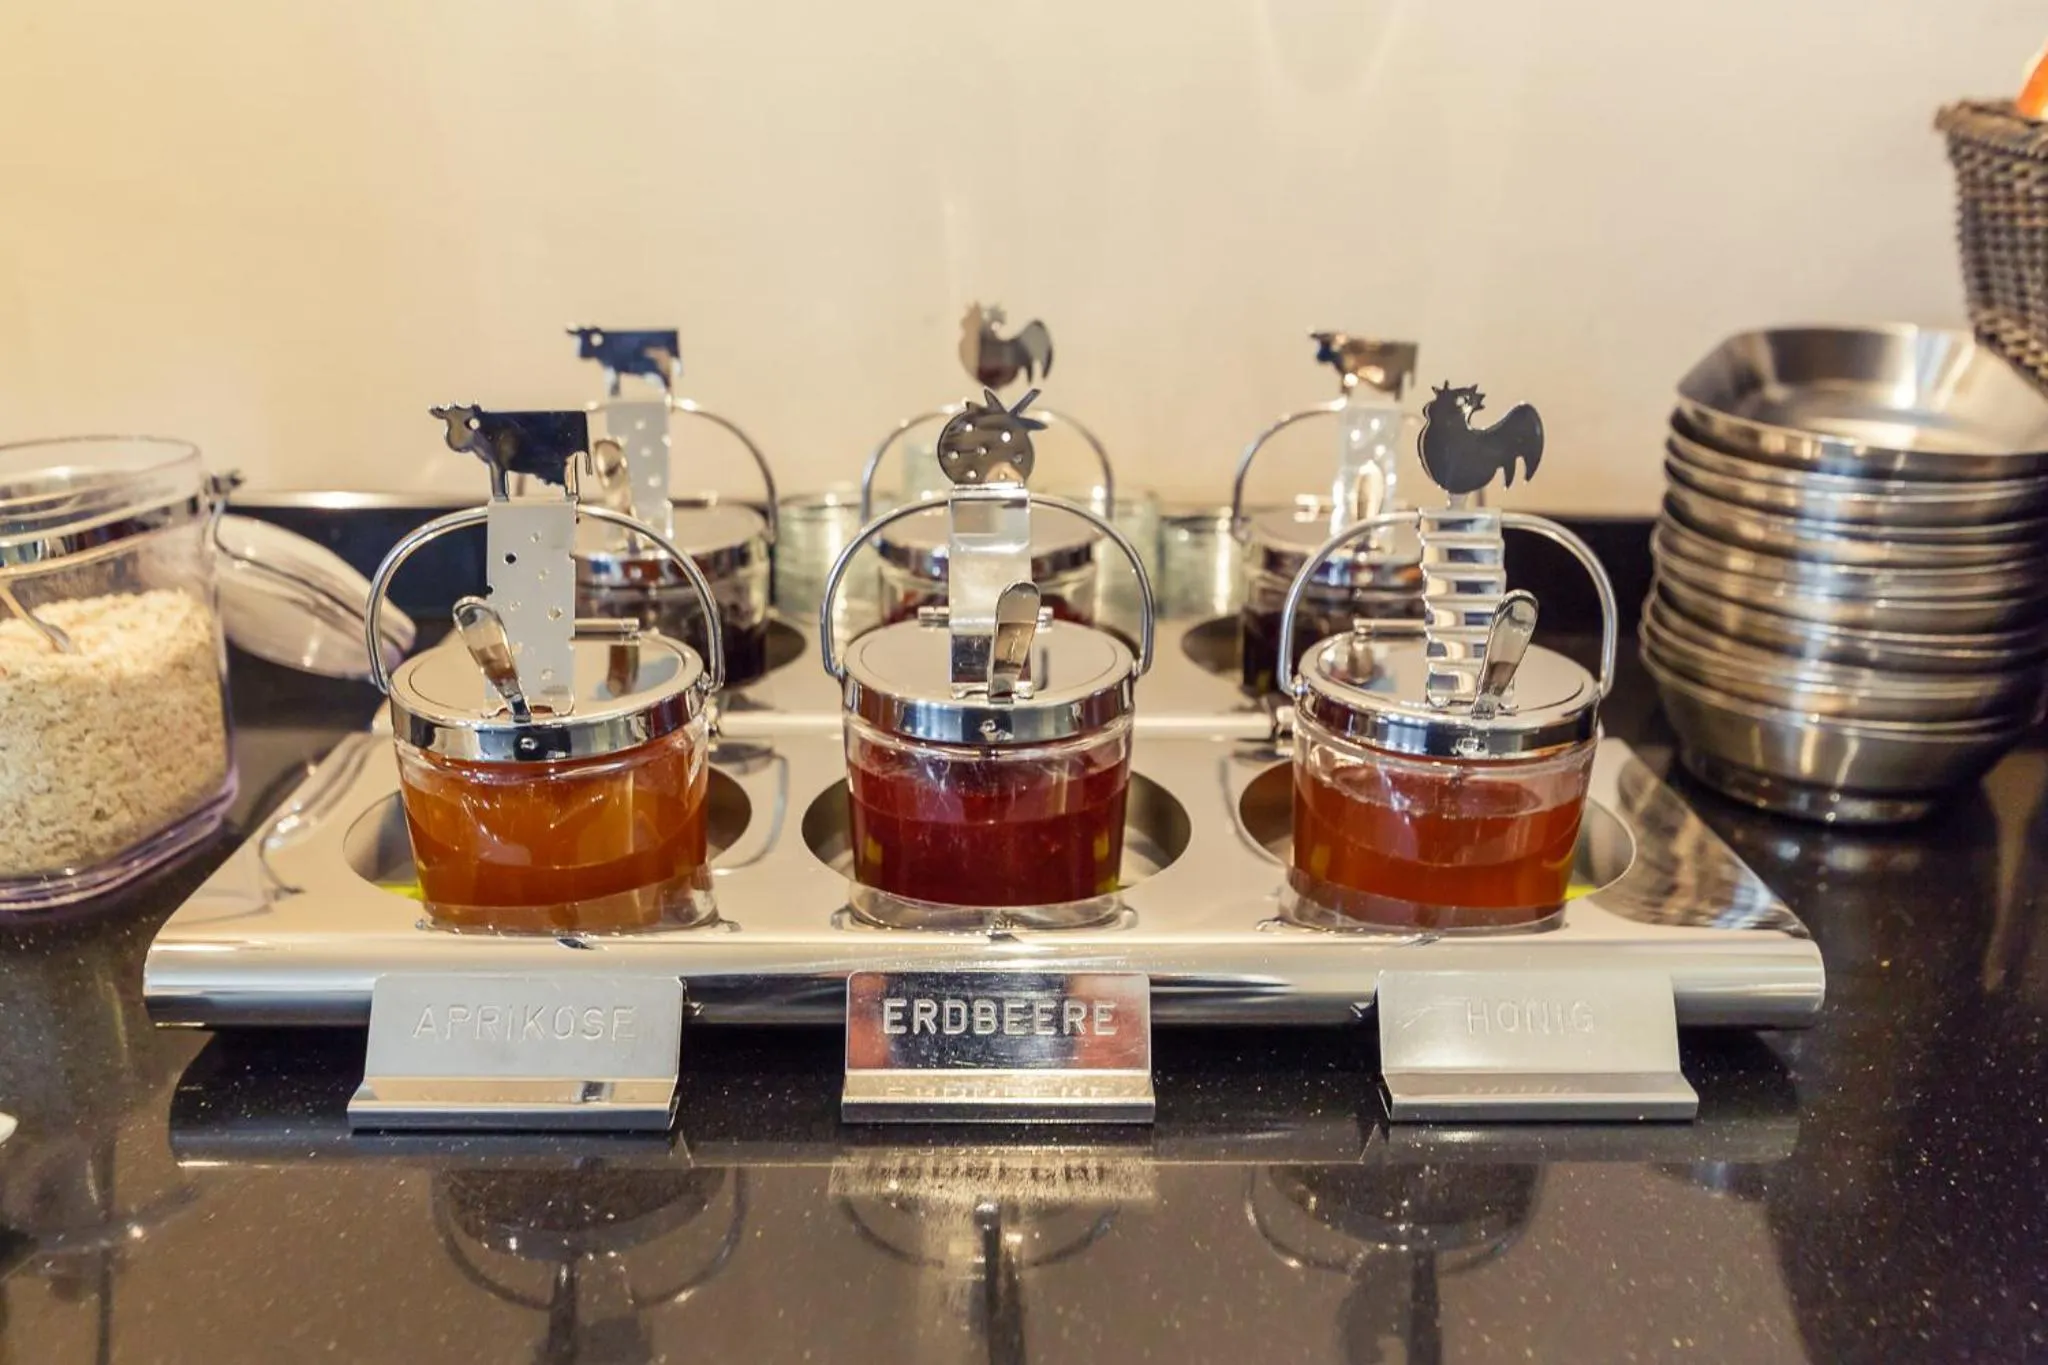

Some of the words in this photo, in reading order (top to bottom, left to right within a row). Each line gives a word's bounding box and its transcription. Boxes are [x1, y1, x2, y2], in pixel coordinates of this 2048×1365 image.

[412, 1004, 637, 1041] APRIKOSE
[882, 998, 1118, 1036] ERDBEERE
[1466, 999, 1595, 1035] HONIG
